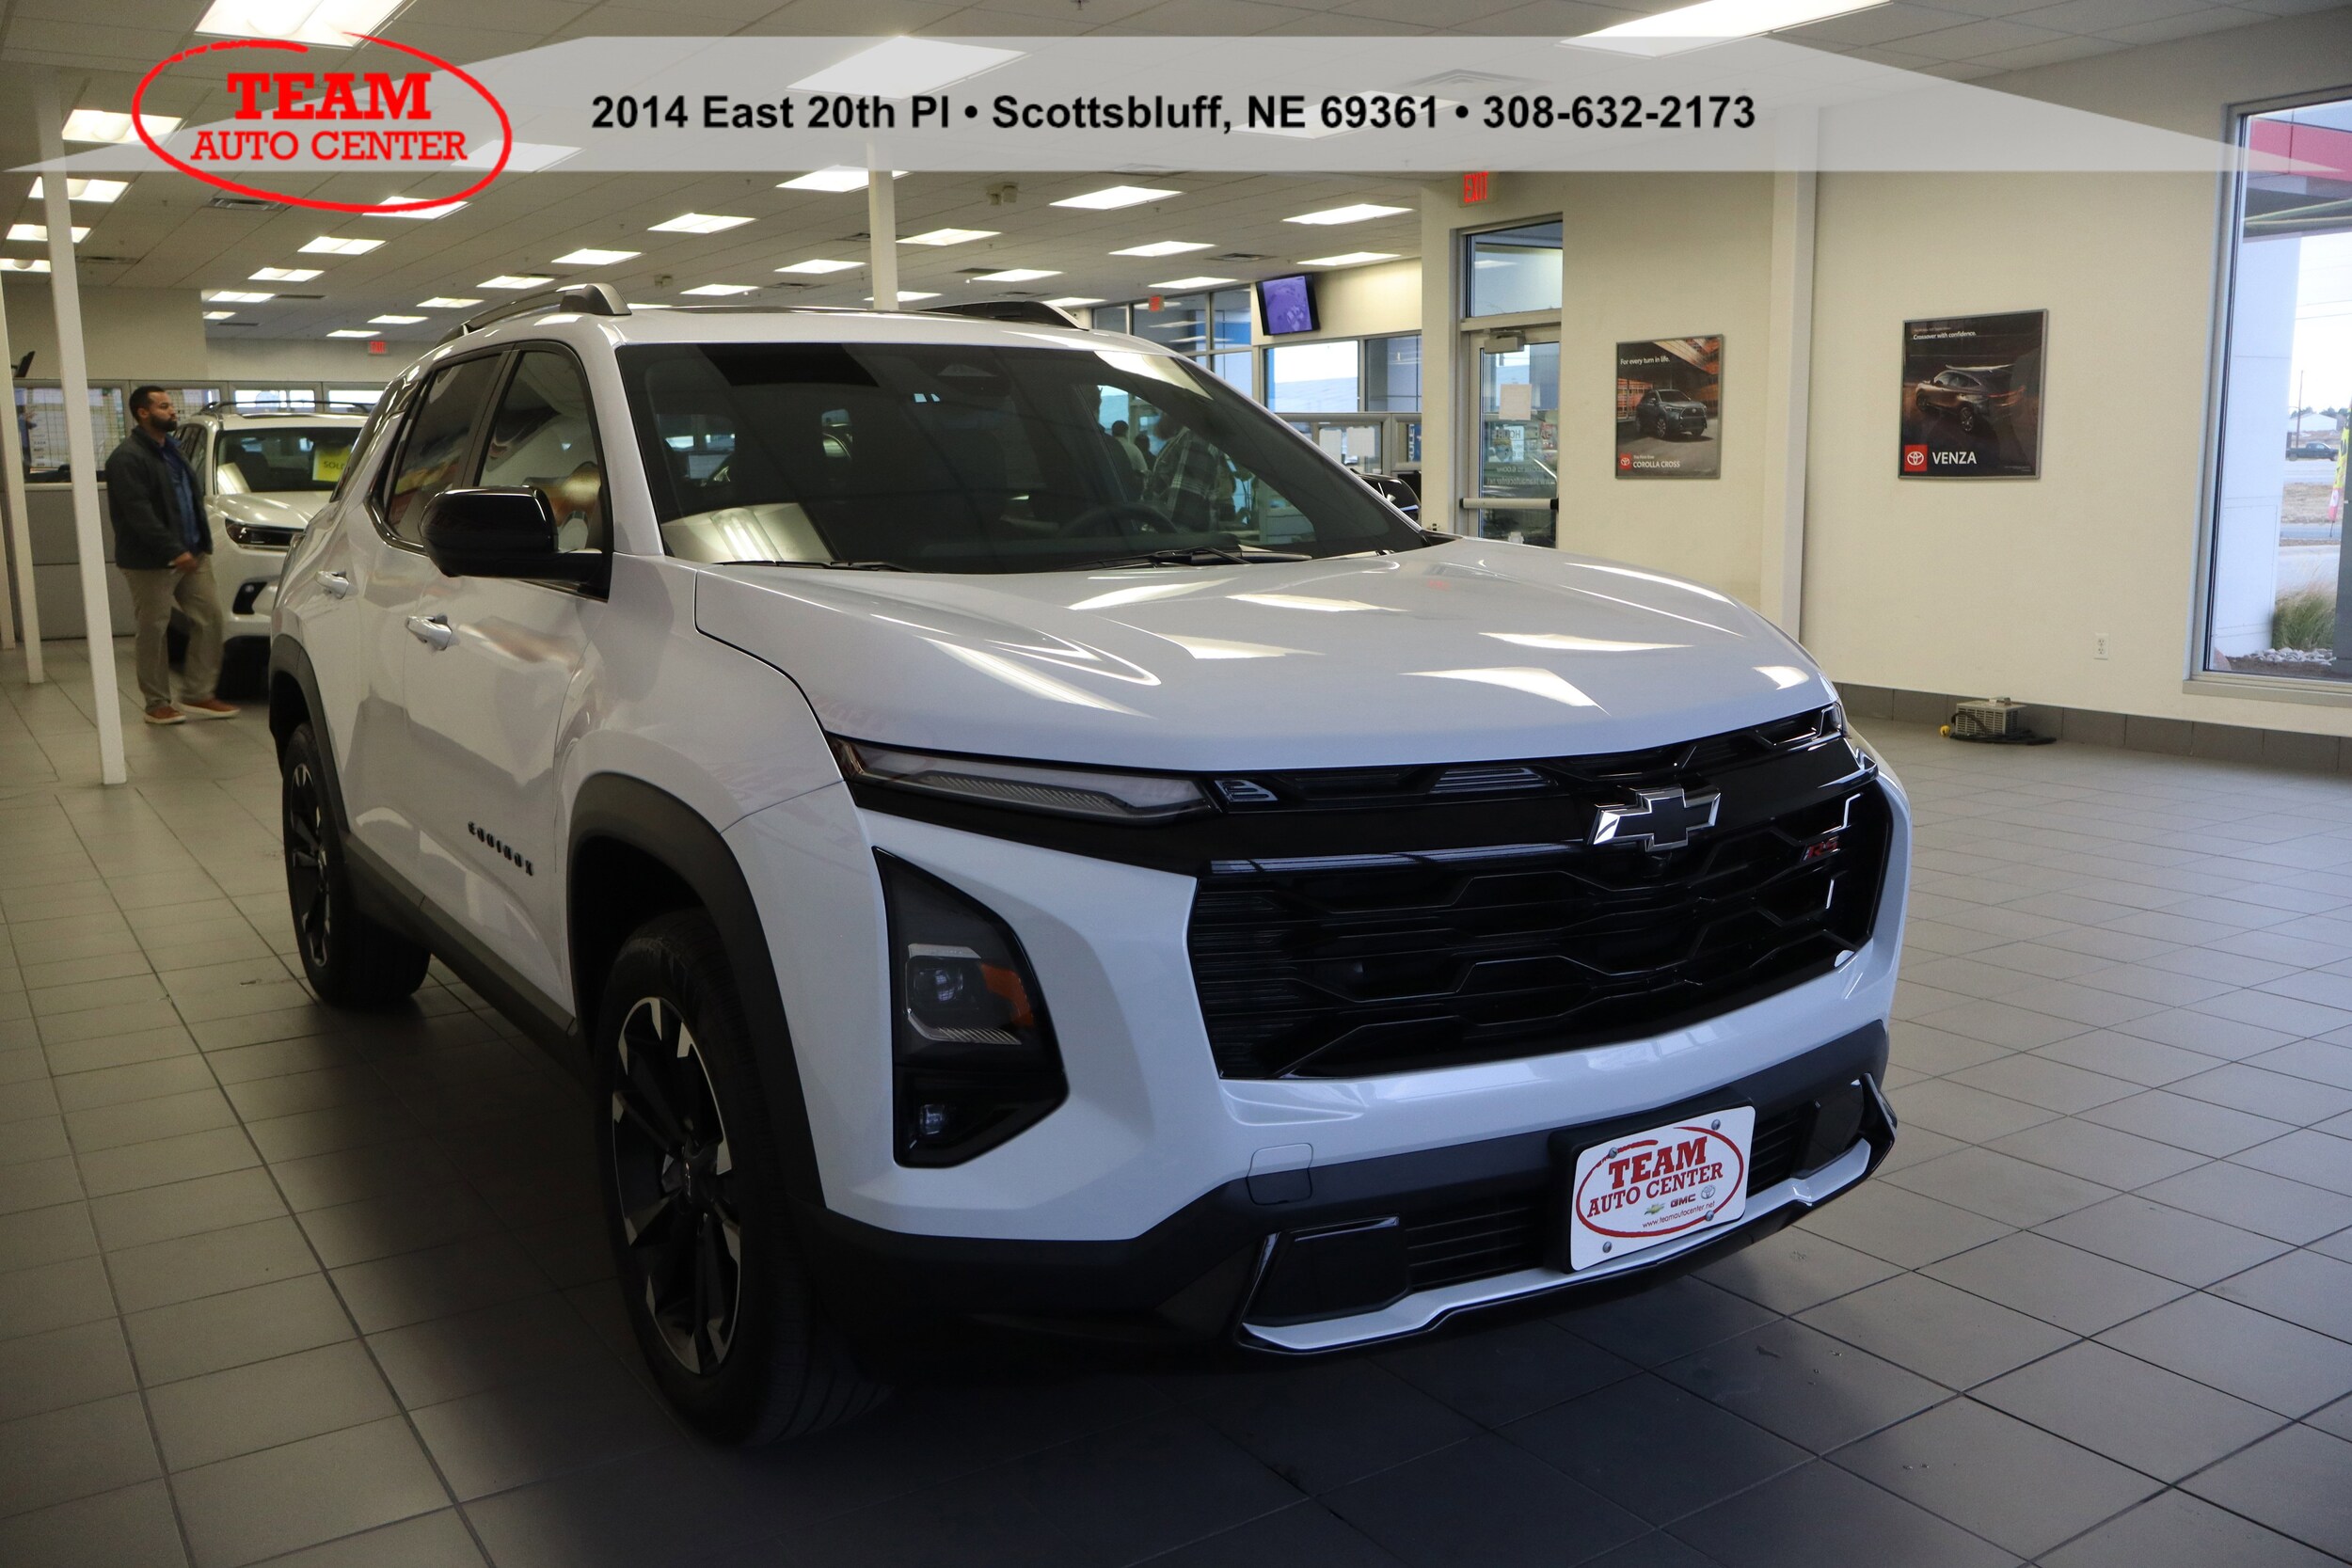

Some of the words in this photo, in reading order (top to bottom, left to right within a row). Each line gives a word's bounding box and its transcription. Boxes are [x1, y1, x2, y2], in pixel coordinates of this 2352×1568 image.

[1463, 171, 1488, 203] EXIT
[1661, 460, 1681, 468] CROSS
[1931, 451, 1978, 465] VENZA
[468, 820, 533, 877] EQUINOX
[1804, 835, 1841, 861] RS
[1608, 1136, 1708, 1190] TEAM
[1587, 1186, 1641, 1218] AUTO
[1645, 1162, 1724, 1199] CENTER
[1670, 1194, 1696, 1209] GMC
[1642, 1200, 1716, 1228] www.teamautocenter.net
